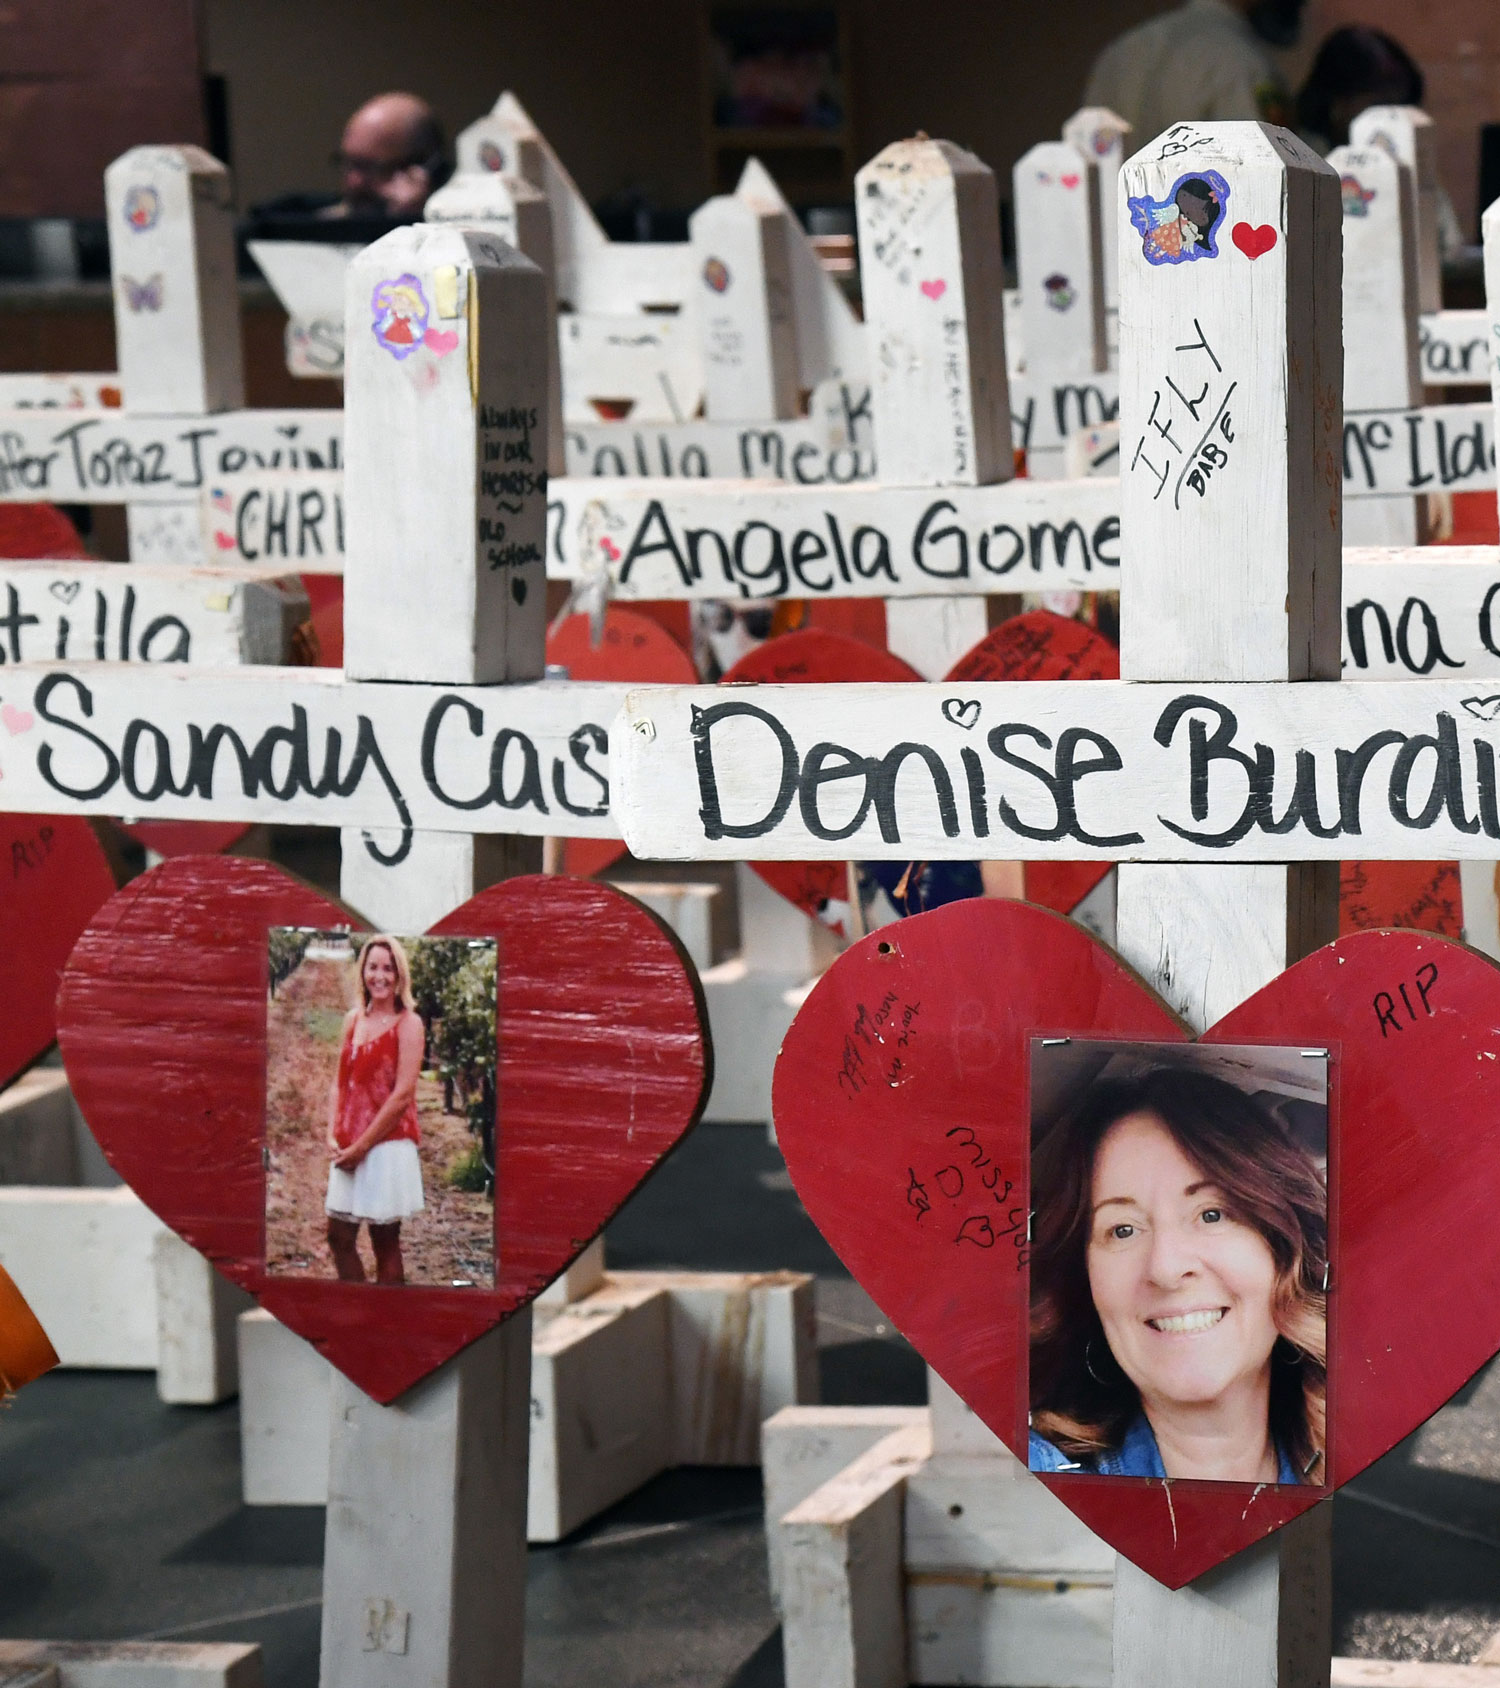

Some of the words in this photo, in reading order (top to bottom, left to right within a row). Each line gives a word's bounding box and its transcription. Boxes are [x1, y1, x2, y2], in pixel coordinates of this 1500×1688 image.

[619, 499, 898, 598] Angela
[912, 499, 1120, 579] Gome
[0, 582, 190, 664] tilla
[34, 672, 414, 866] Sandy
[420, 694, 608, 816] Cas
[690, 697, 1145, 848] Denise
[1373, 963, 1438, 1038] RIP
